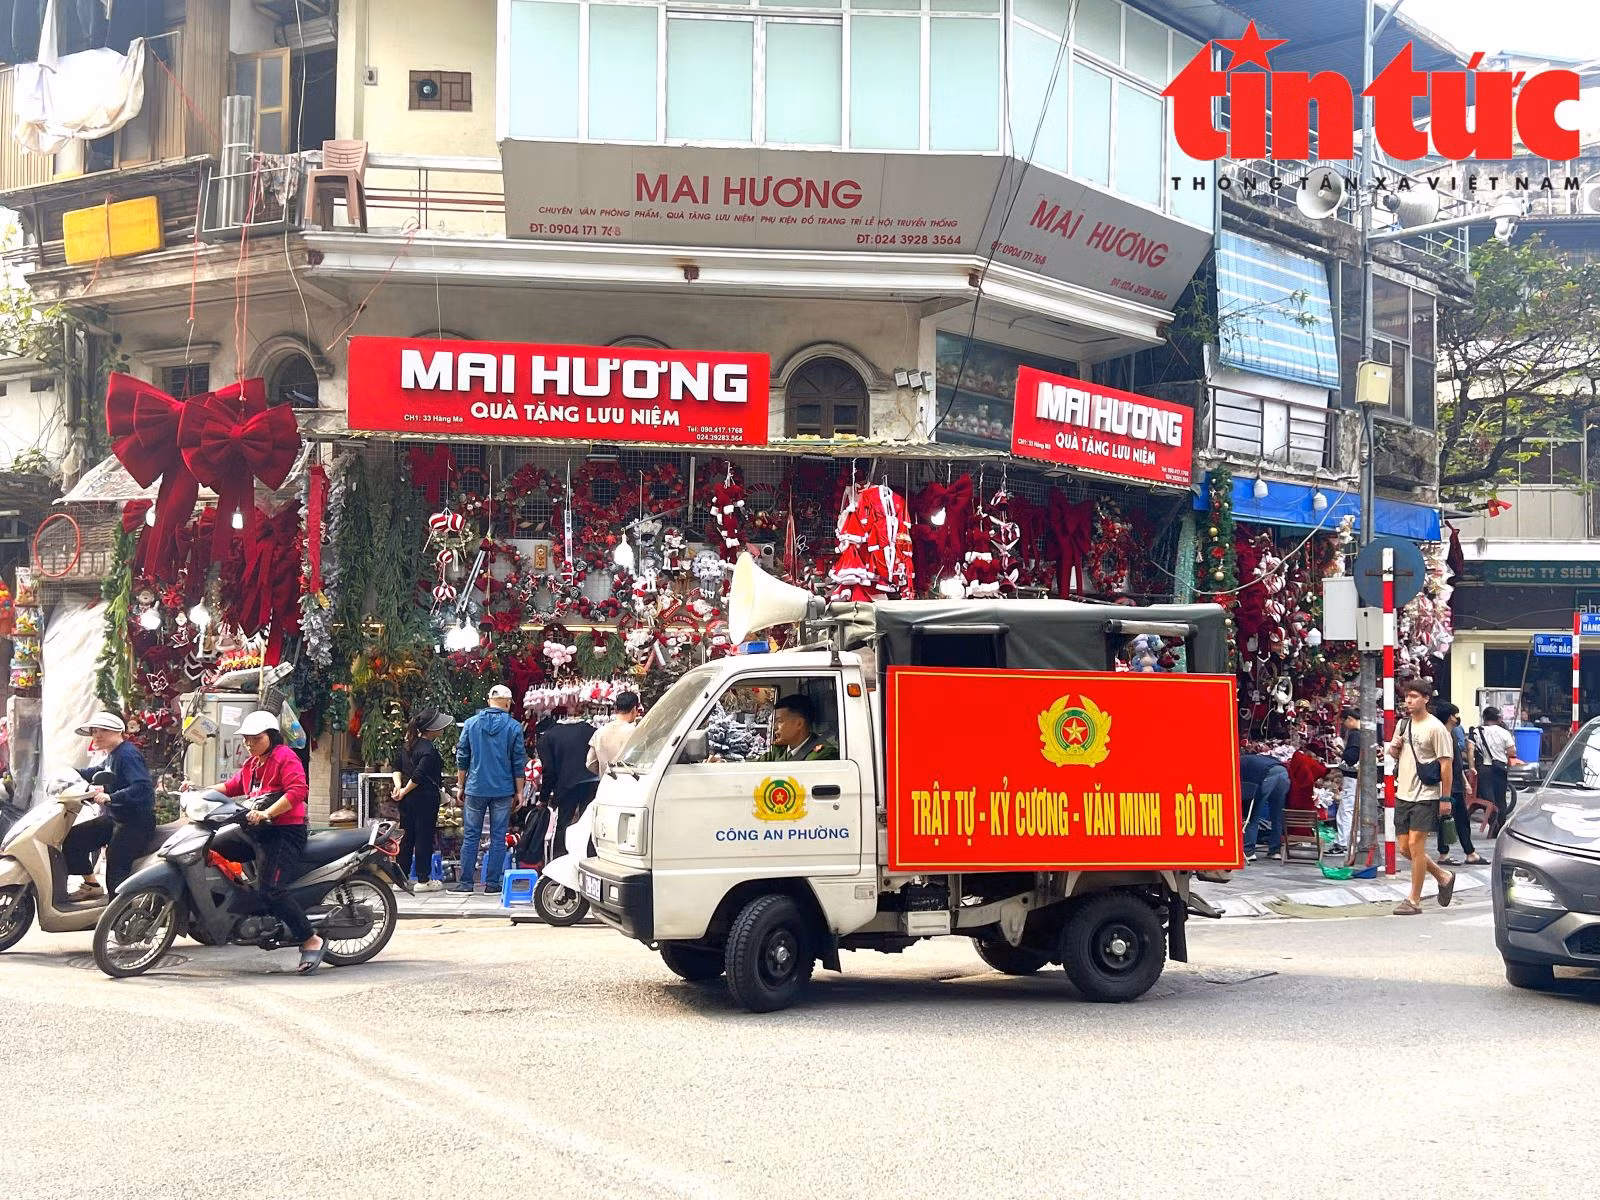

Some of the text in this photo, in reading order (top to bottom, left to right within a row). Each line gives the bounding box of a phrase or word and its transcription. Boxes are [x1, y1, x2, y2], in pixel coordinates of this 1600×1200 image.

[636, 173, 862, 209] MAI HƯƠNG
[539, 206, 573, 215] CHUYÊN
[667, 210, 685, 220] QUÀ
[715, 213, 730, 221] LƯU
[818, 217, 846, 225] TRANG
[549, 224, 579, 235] 0904
[582, 225, 597, 236] 171
[900, 235, 928, 245] 3928
[932, 235, 961, 245] 3564
[1029, 200, 1169, 268] MAI HƯƠNG
[401, 349, 749, 404] MAI HƯƠNG
[404, 414, 421, 422] CH1:
[470, 400, 681, 429] QUÀ TẶNG LƯU NIỆM
[1036, 382, 1183, 447] MAI HƯƠNG
[687, 425, 699, 433] Tel:
[1055, 431, 1156, 466] QUÀ TẶNG LƯU NIỆM
[1540, 567, 1556, 578] TY
[912, 781, 951, 846] TRẬT
[955, 786, 976, 846] TỰ
[990, 776, 1010, 836] KỶ
[1015, 787, 1069, 836] CƯƠNG
[1083, 783, 1116, 836] VĂN
[1119, 793, 1161, 836] MINH
[1175, 784, 1196, 836] ĐÔ
[1200, 793, 1224, 847] THỊ
[716, 825, 849, 841] CÔNG AN PHƯỜNG
